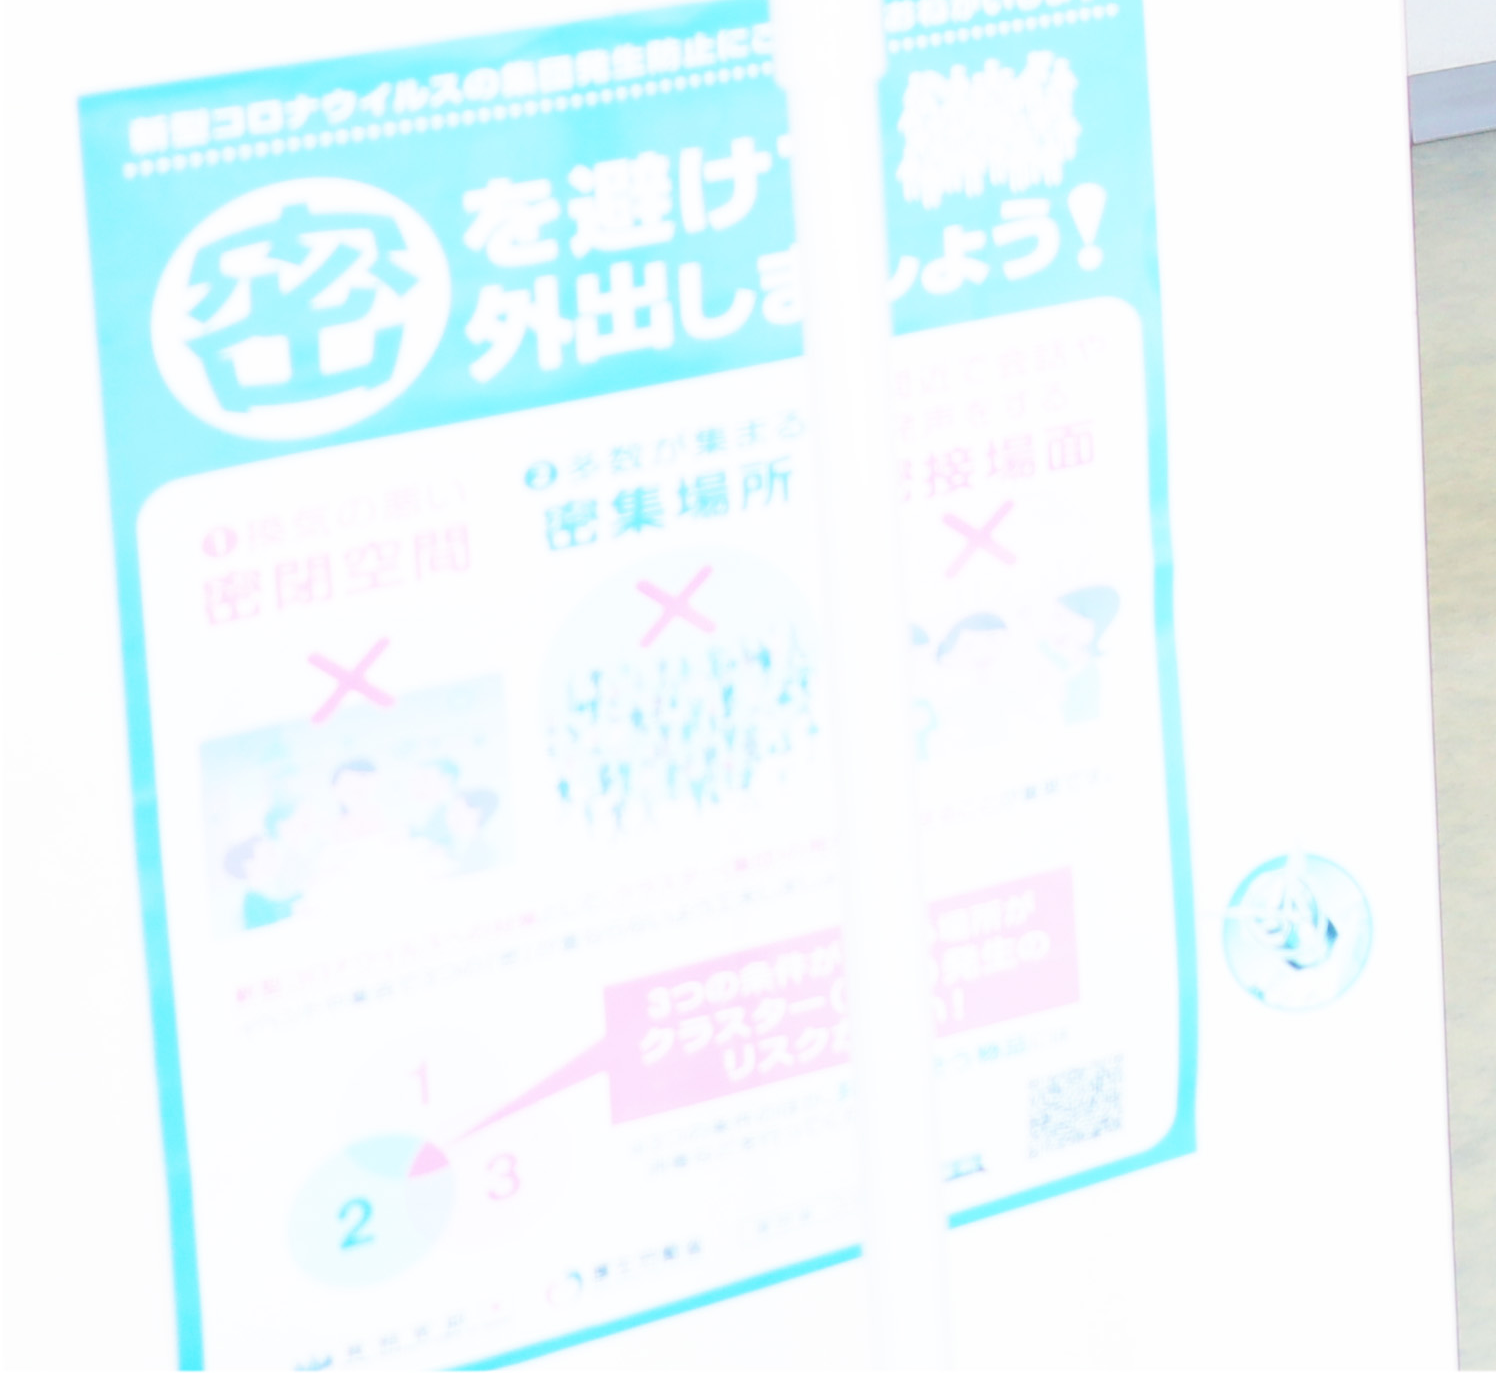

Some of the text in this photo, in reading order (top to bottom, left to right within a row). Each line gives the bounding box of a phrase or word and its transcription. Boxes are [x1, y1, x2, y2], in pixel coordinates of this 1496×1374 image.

[462, 133, 798, 265] を避け
[541, 456, 797, 557] 密集場所
[200, 521, 476, 629] 密閉空間
[337, 1196, 376, 1251] 2
[485, 1151, 523, 1203] 3
